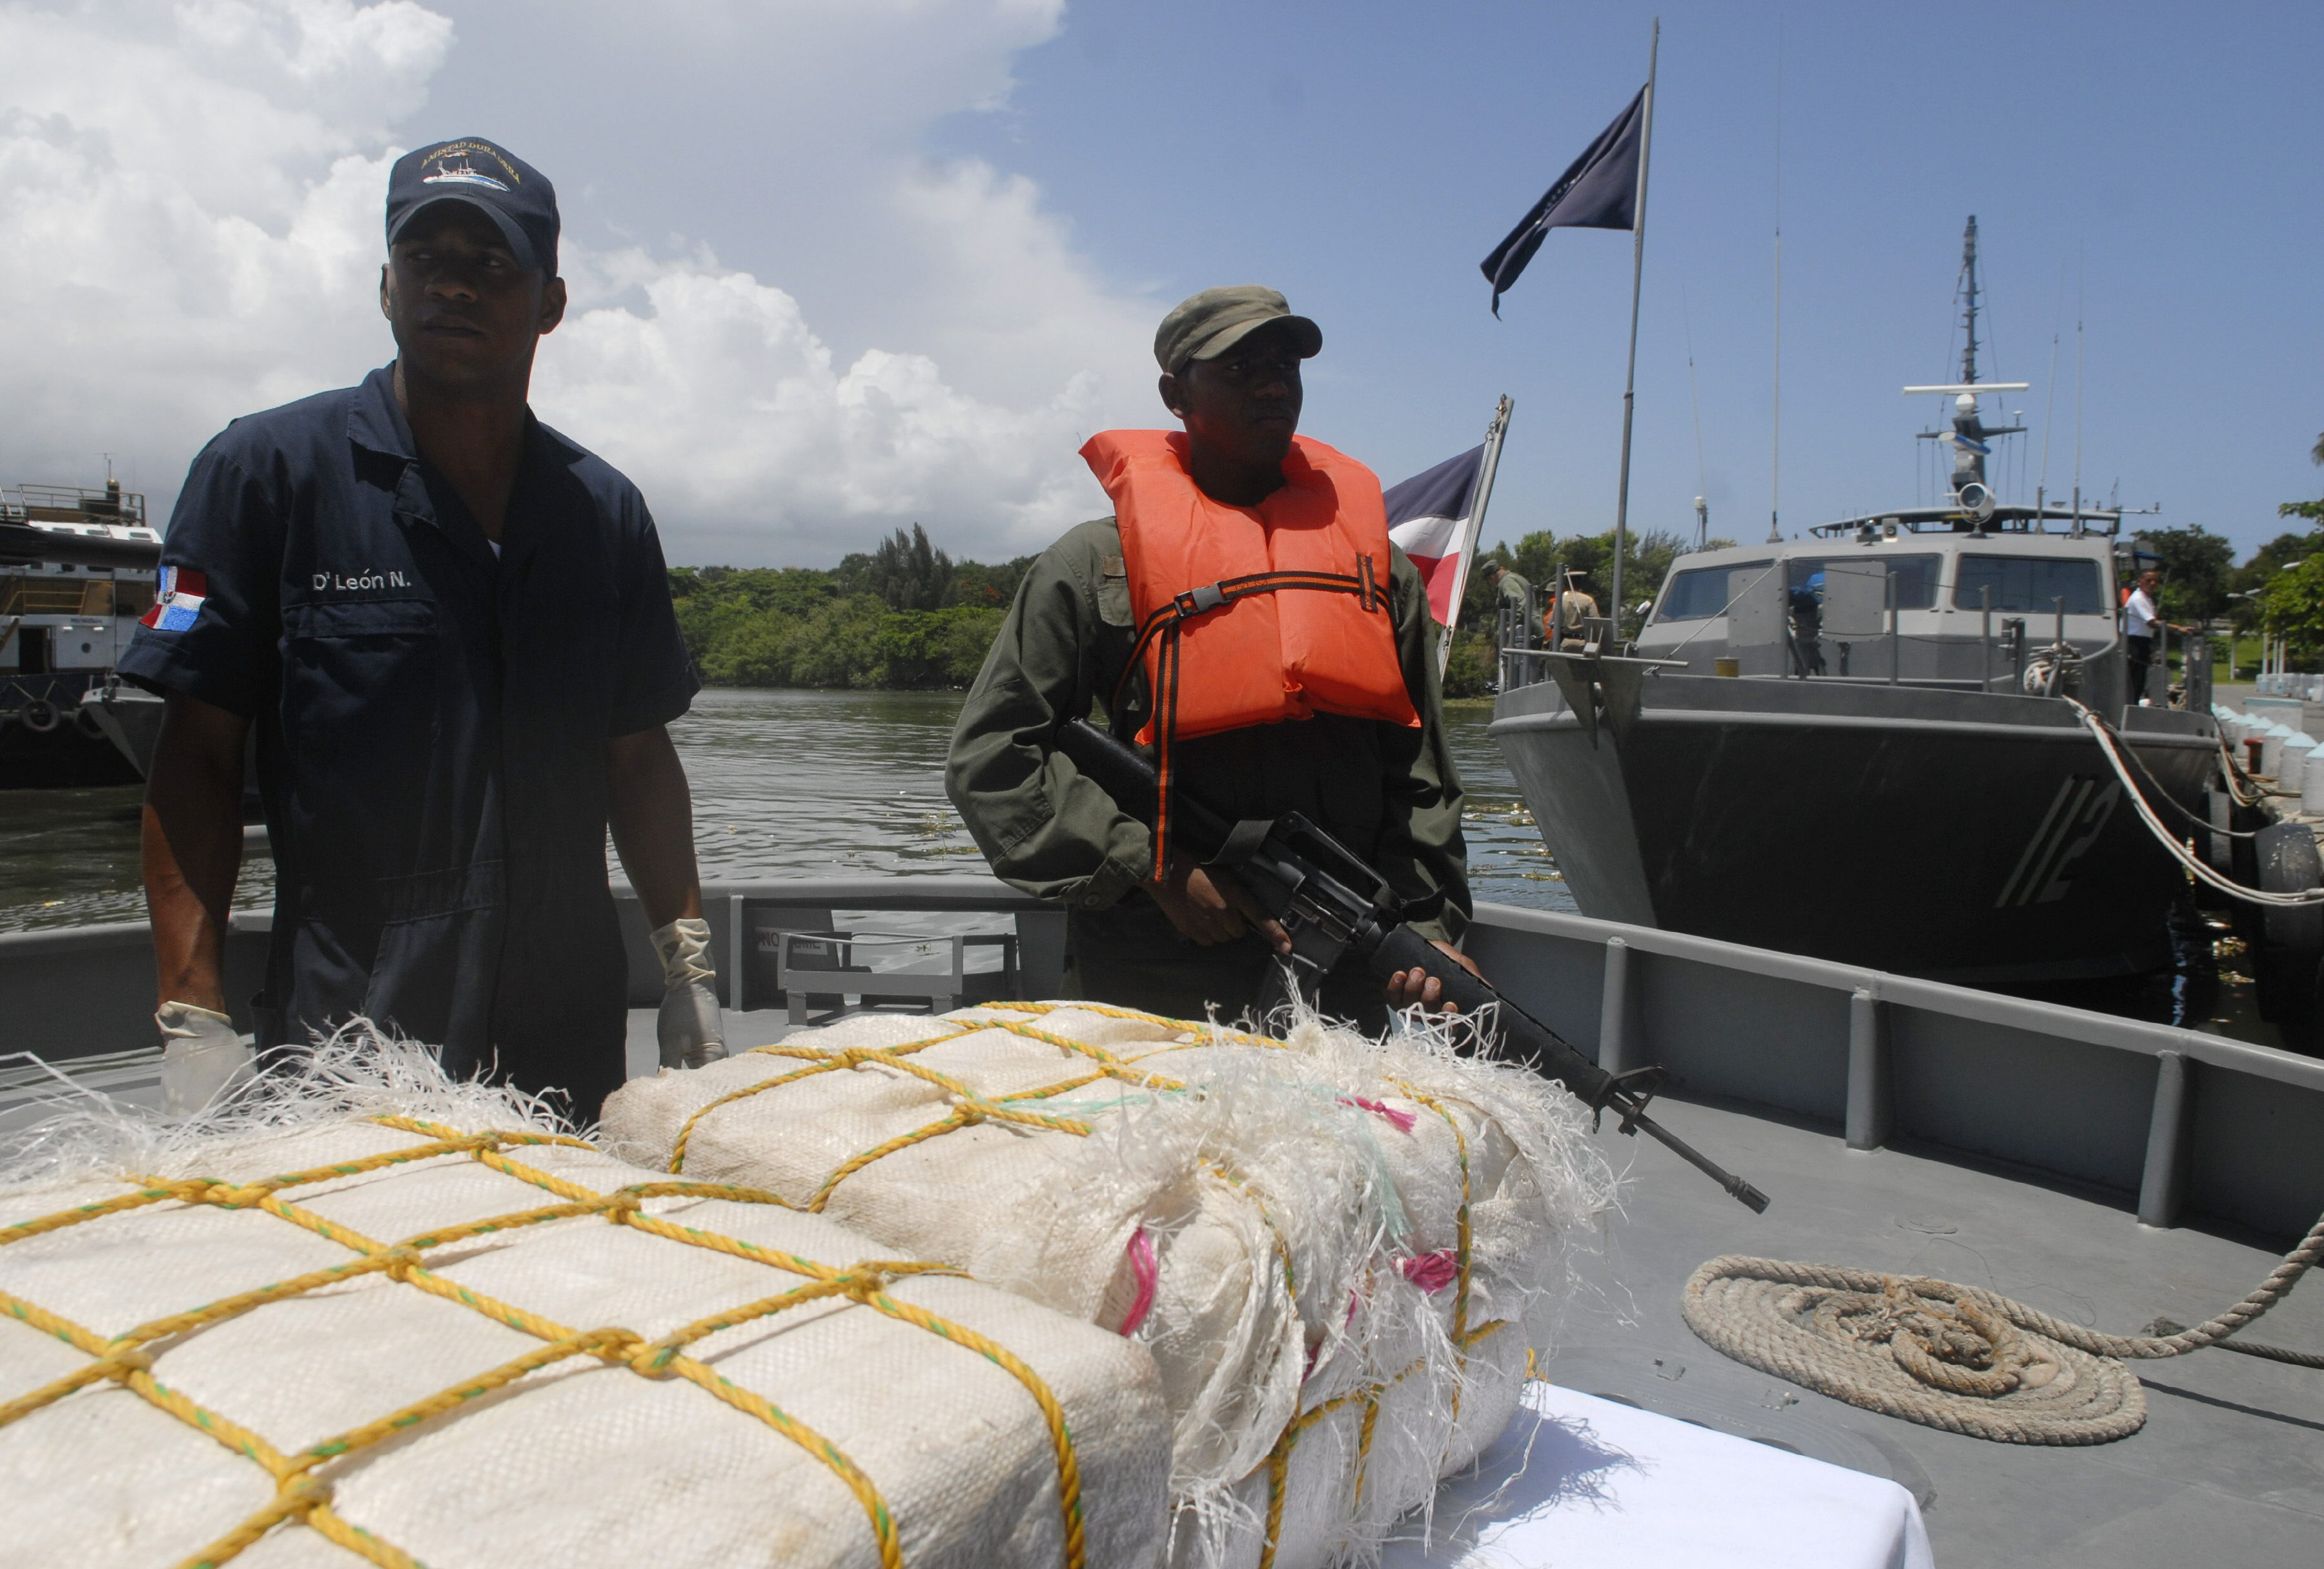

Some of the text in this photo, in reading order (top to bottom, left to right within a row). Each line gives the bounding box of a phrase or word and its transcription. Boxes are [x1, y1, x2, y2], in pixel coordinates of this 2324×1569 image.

[421, 141, 466, 169] AMISTAD
[389, 571, 412, 588] N.
[1994, 775, 2122, 908] 112
